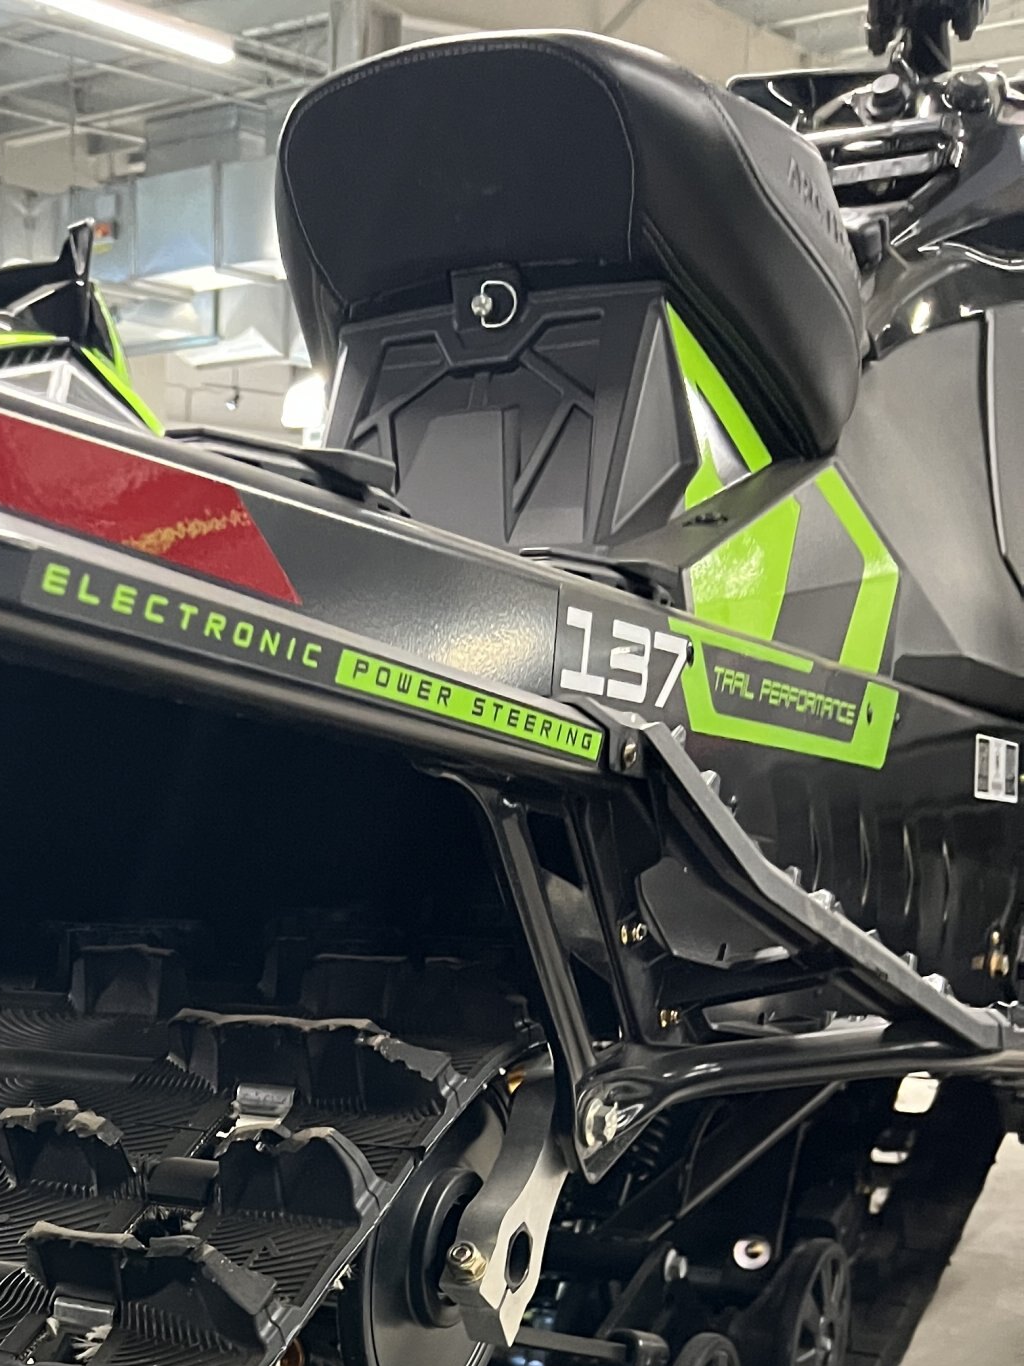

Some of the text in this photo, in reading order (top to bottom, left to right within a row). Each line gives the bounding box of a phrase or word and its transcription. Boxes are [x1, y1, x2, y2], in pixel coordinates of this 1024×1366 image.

[41, 562, 593, 750] ELECTRONIC POWER STEERING
[560, 606, 689, 709] 137
[713, 665, 857, 726] TRAIL PERFORMANCE
